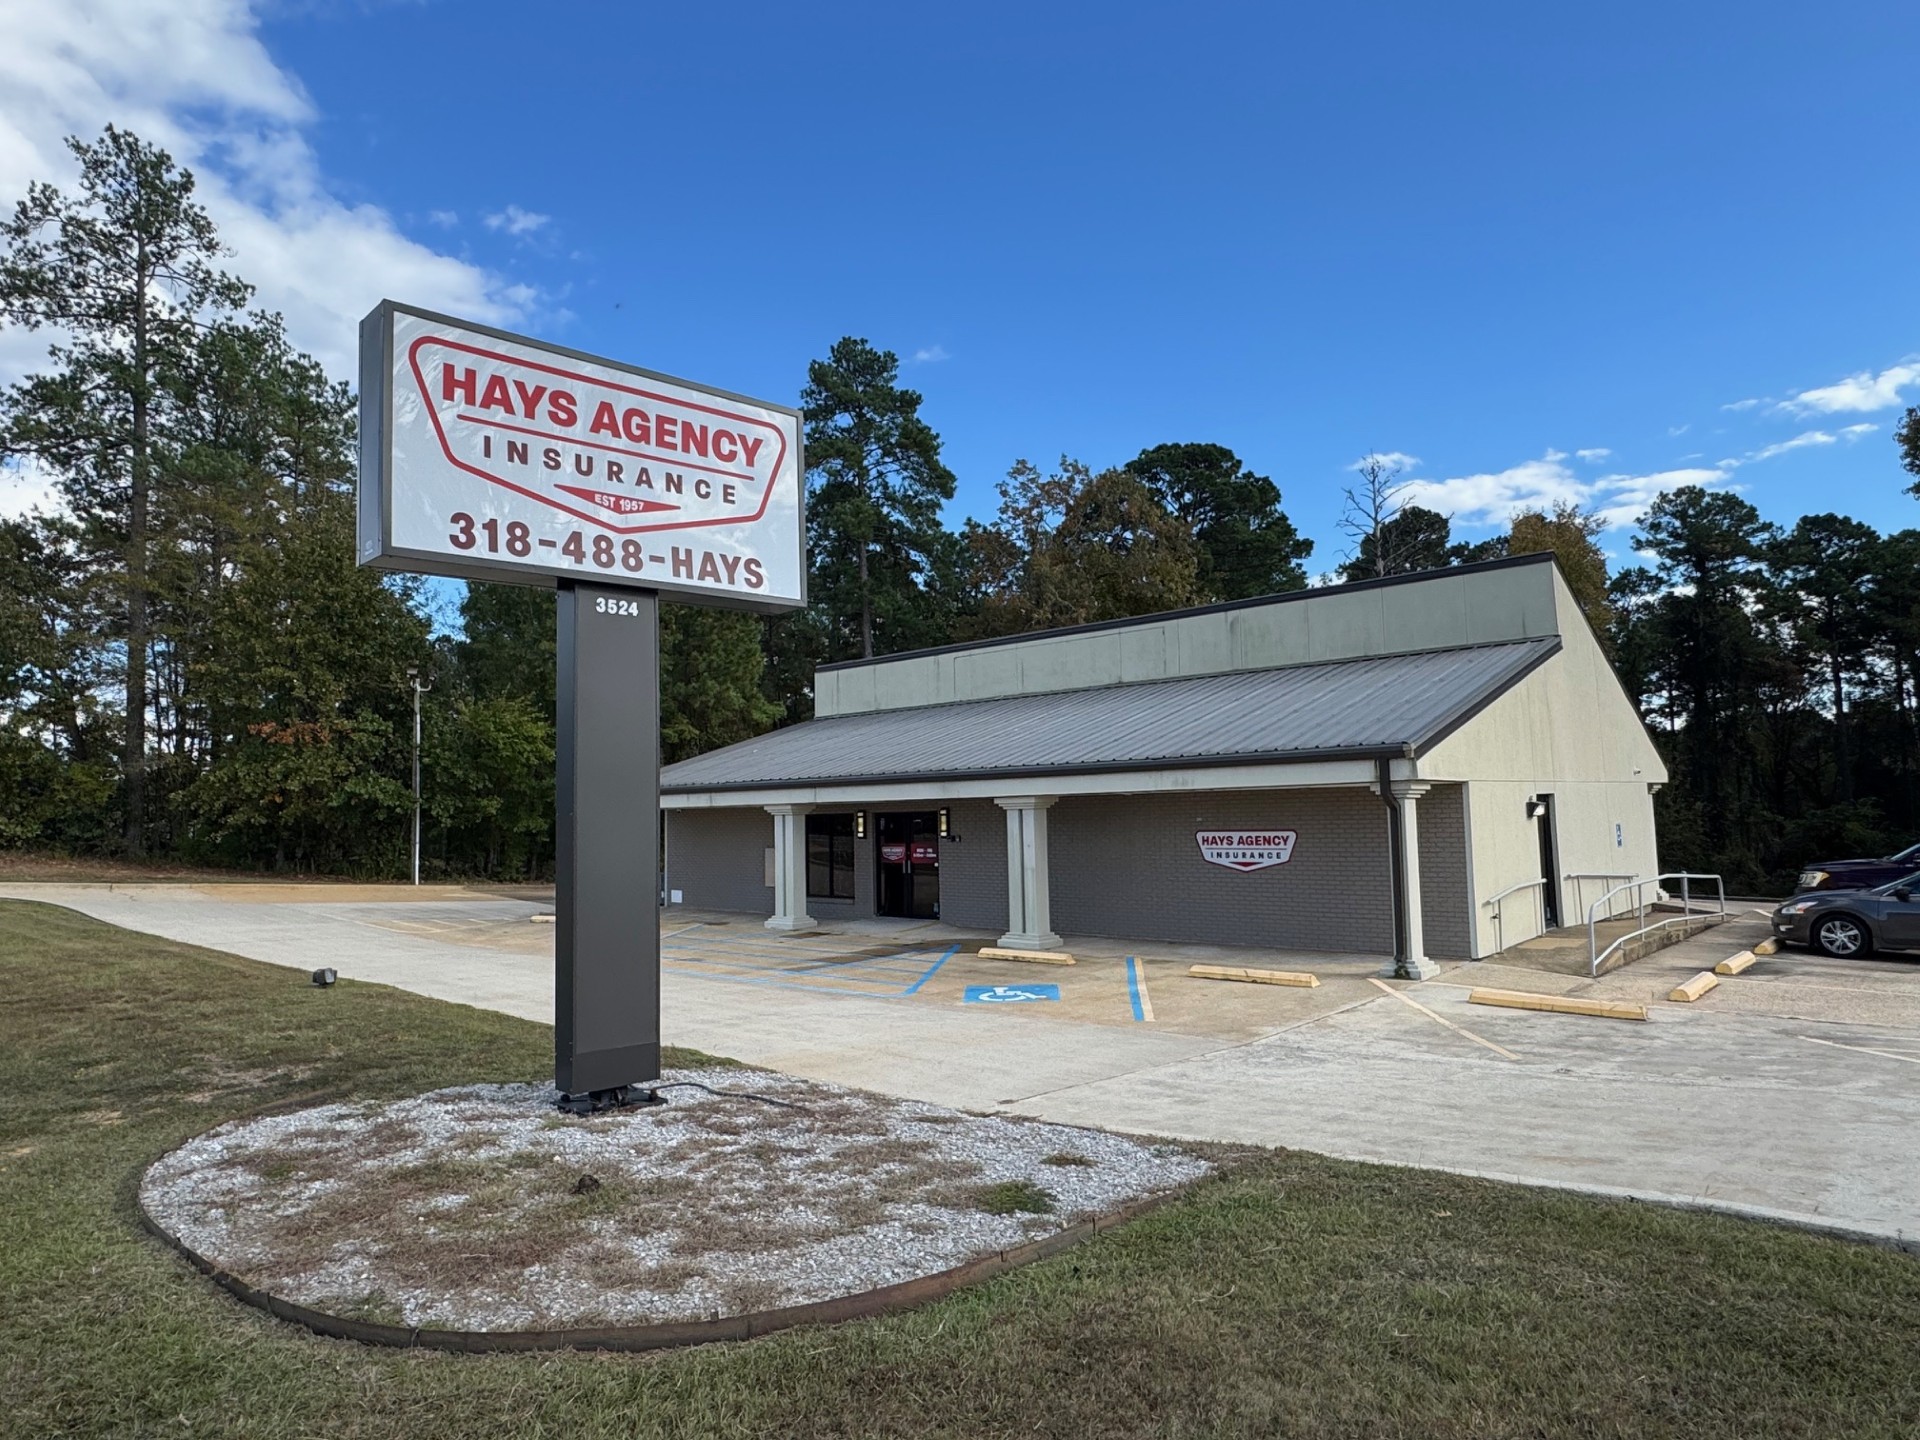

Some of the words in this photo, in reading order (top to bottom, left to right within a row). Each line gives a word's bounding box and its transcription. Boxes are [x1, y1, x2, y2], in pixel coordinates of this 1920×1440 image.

[443, 362, 578, 428] HAYS
[589, 400, 764, 468] AGENCY
[483, 435, 736, 505] INSURANCE
[594, 493, 616, 509] EST
[619, 499, 645, 512] 1957
[449, 511, 764, 589] 318-488-HAYS
[595, 597, 639, 617] 3524
[1202, 835, 1234, 846] HAYS
[1237, 835, 1290, 846] AGENCY
